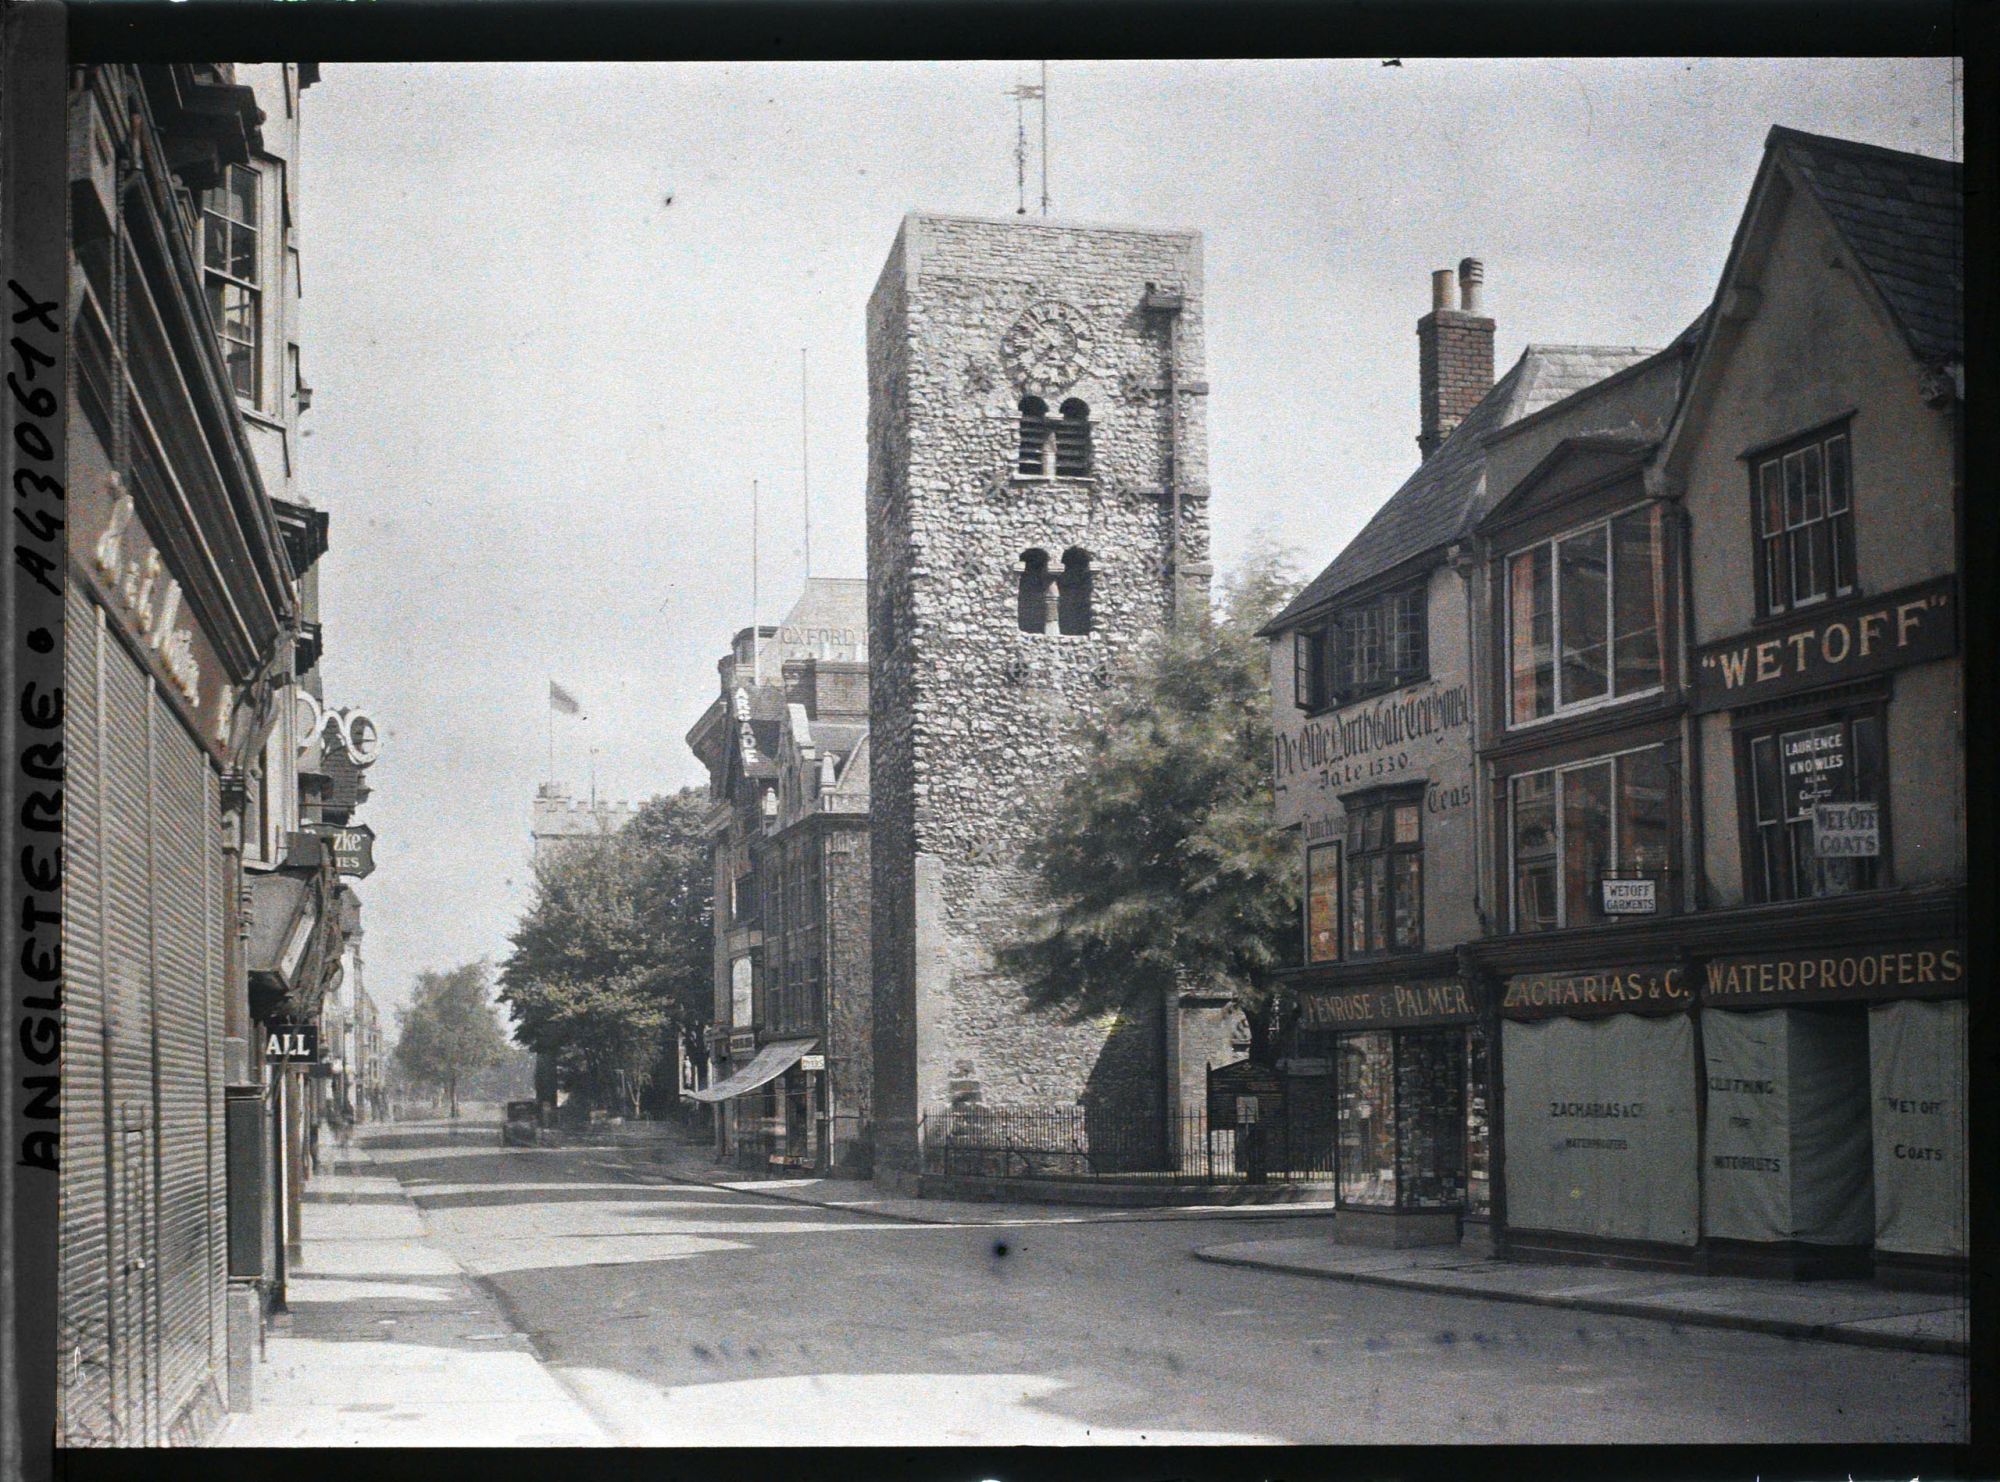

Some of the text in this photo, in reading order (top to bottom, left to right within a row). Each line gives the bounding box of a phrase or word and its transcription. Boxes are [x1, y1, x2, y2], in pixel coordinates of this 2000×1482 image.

[1785, 734, 1843, 757] LAURENCE
[1789, 754, 1844, 775] KNOWLES
[1820, 835, 1875, 854] COATS
[1606, 898, 1655, 910] GARMENTS
[1704, 950, 1963, 995] WATERPROOFERS
[1503, 973, 1644, 1008] ZACHARIAS
[1648, 978, 1661, 999] &
[1894, 1144, 1943, 1161] COATS
